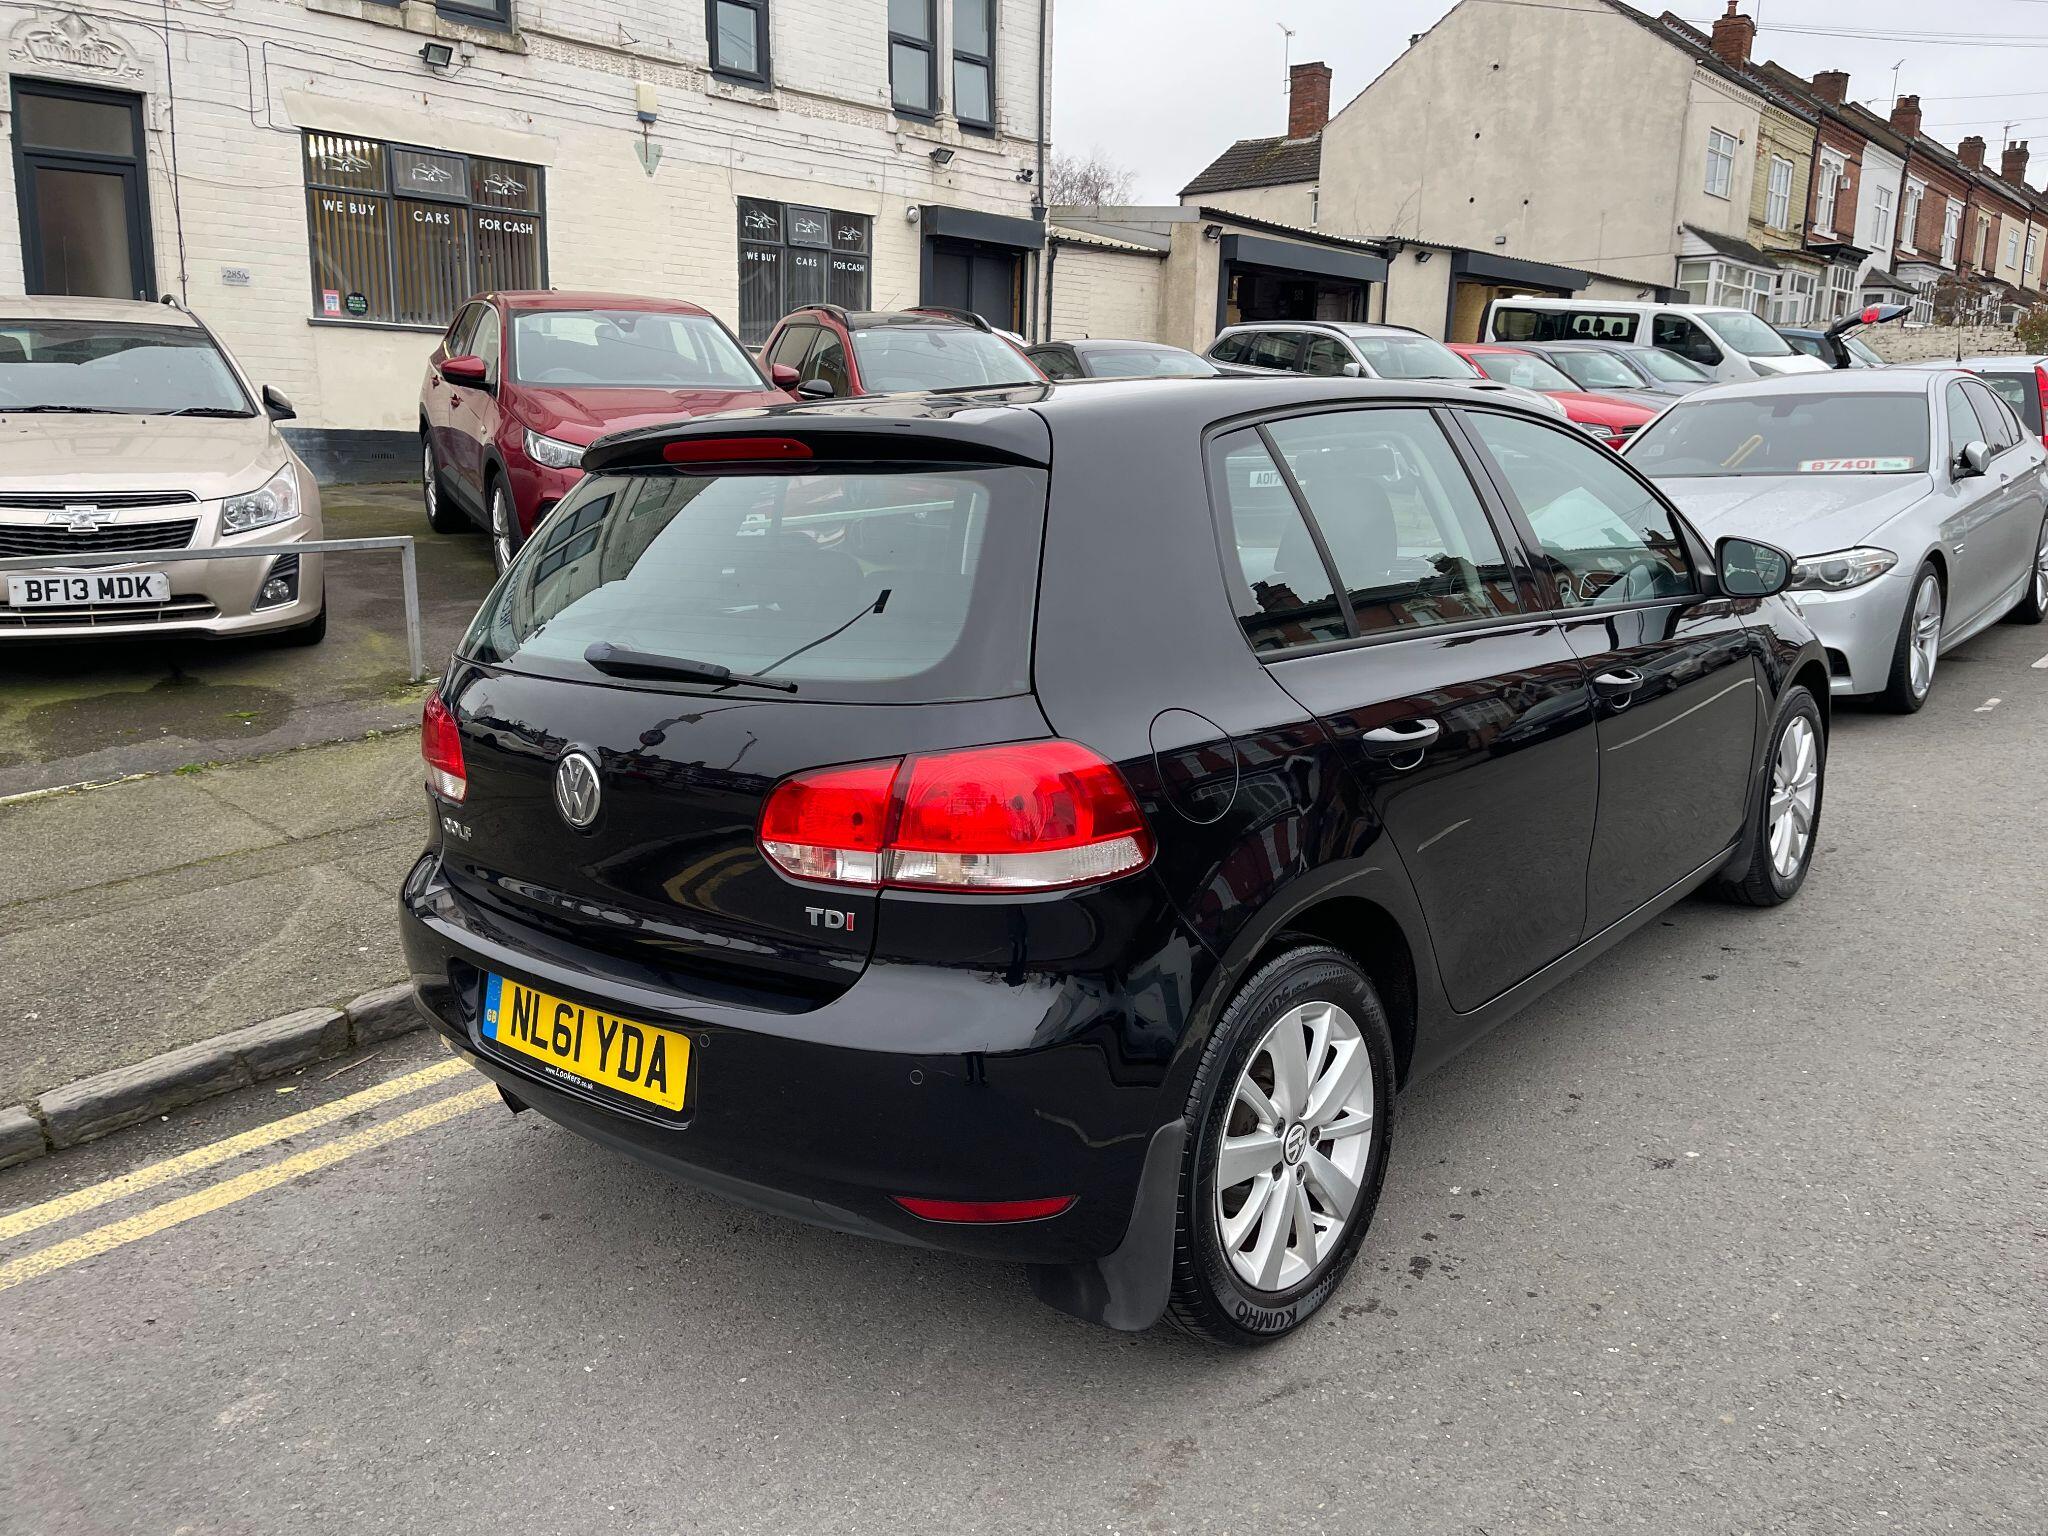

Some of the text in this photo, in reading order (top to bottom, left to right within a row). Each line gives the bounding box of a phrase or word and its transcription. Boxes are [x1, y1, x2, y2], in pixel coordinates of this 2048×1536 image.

[322, 199, 376, 216] WE BUY
[413, 210, 451, 225] CARS
[479, 217, 533, 235] FOR CASH
[746, 251, 776, 262] WE BUY
[795, 257, 818, 267] CARS
[833, 261, 865, 272] FOR CASH
[24, 576, 153, 602] BF13 MDK
[805, 906, 855, 931] TDI
[510, 986, 667, 1094] NL61 YDA
[1235, 1300, 1298, 1331] KUMHO
